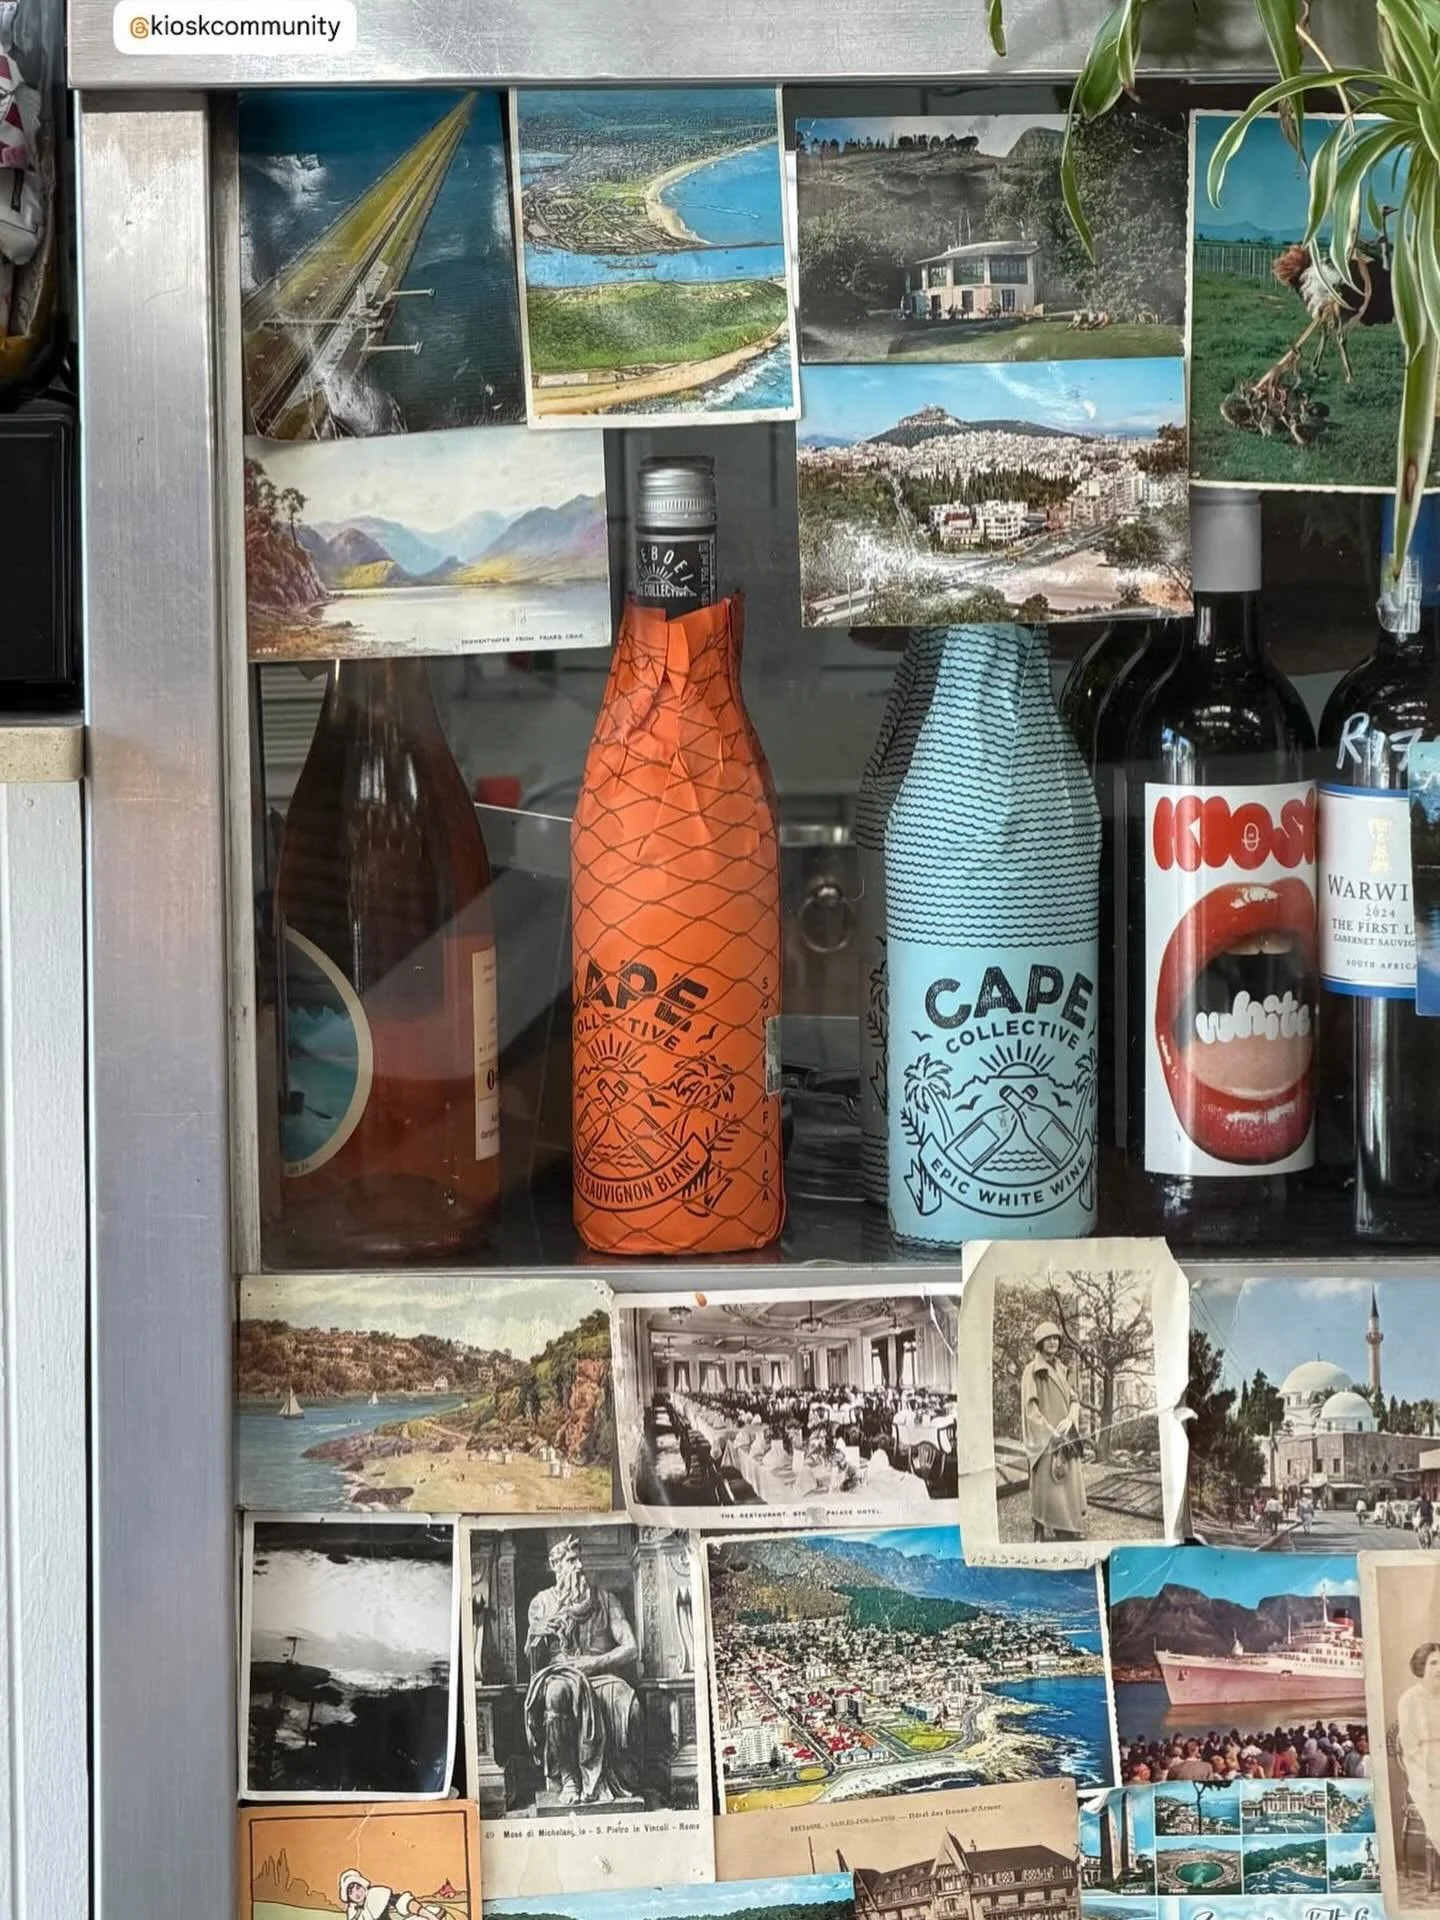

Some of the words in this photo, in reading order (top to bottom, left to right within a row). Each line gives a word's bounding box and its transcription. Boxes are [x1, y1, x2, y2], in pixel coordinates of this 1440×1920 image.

[1331, 917, 1354, 932] THE
[1357, 921, 1399, 936] FIRST
[1365, 908, 1396, 919] 2024
[1333, 933, 1375, 947] CABERNET
[1345, 959, 1375, 969] SOUTH
[924, 963, 1094, 1030] CAPE
[1194, 989, 1311, 1045] white
[945, 1019, 1080, 1054] COLLECTIVE
[583, 1176, 654, 1204] SAUVIGNON
[655, 1151, 701, 1192] BLANC
[930, 1157, 971, 1195] EPIC
[978, 1188, 1045, 1207] WHITE
[1049, 1155, 1087, 1197] WINE
[526, 1829, 534, 1838] di
